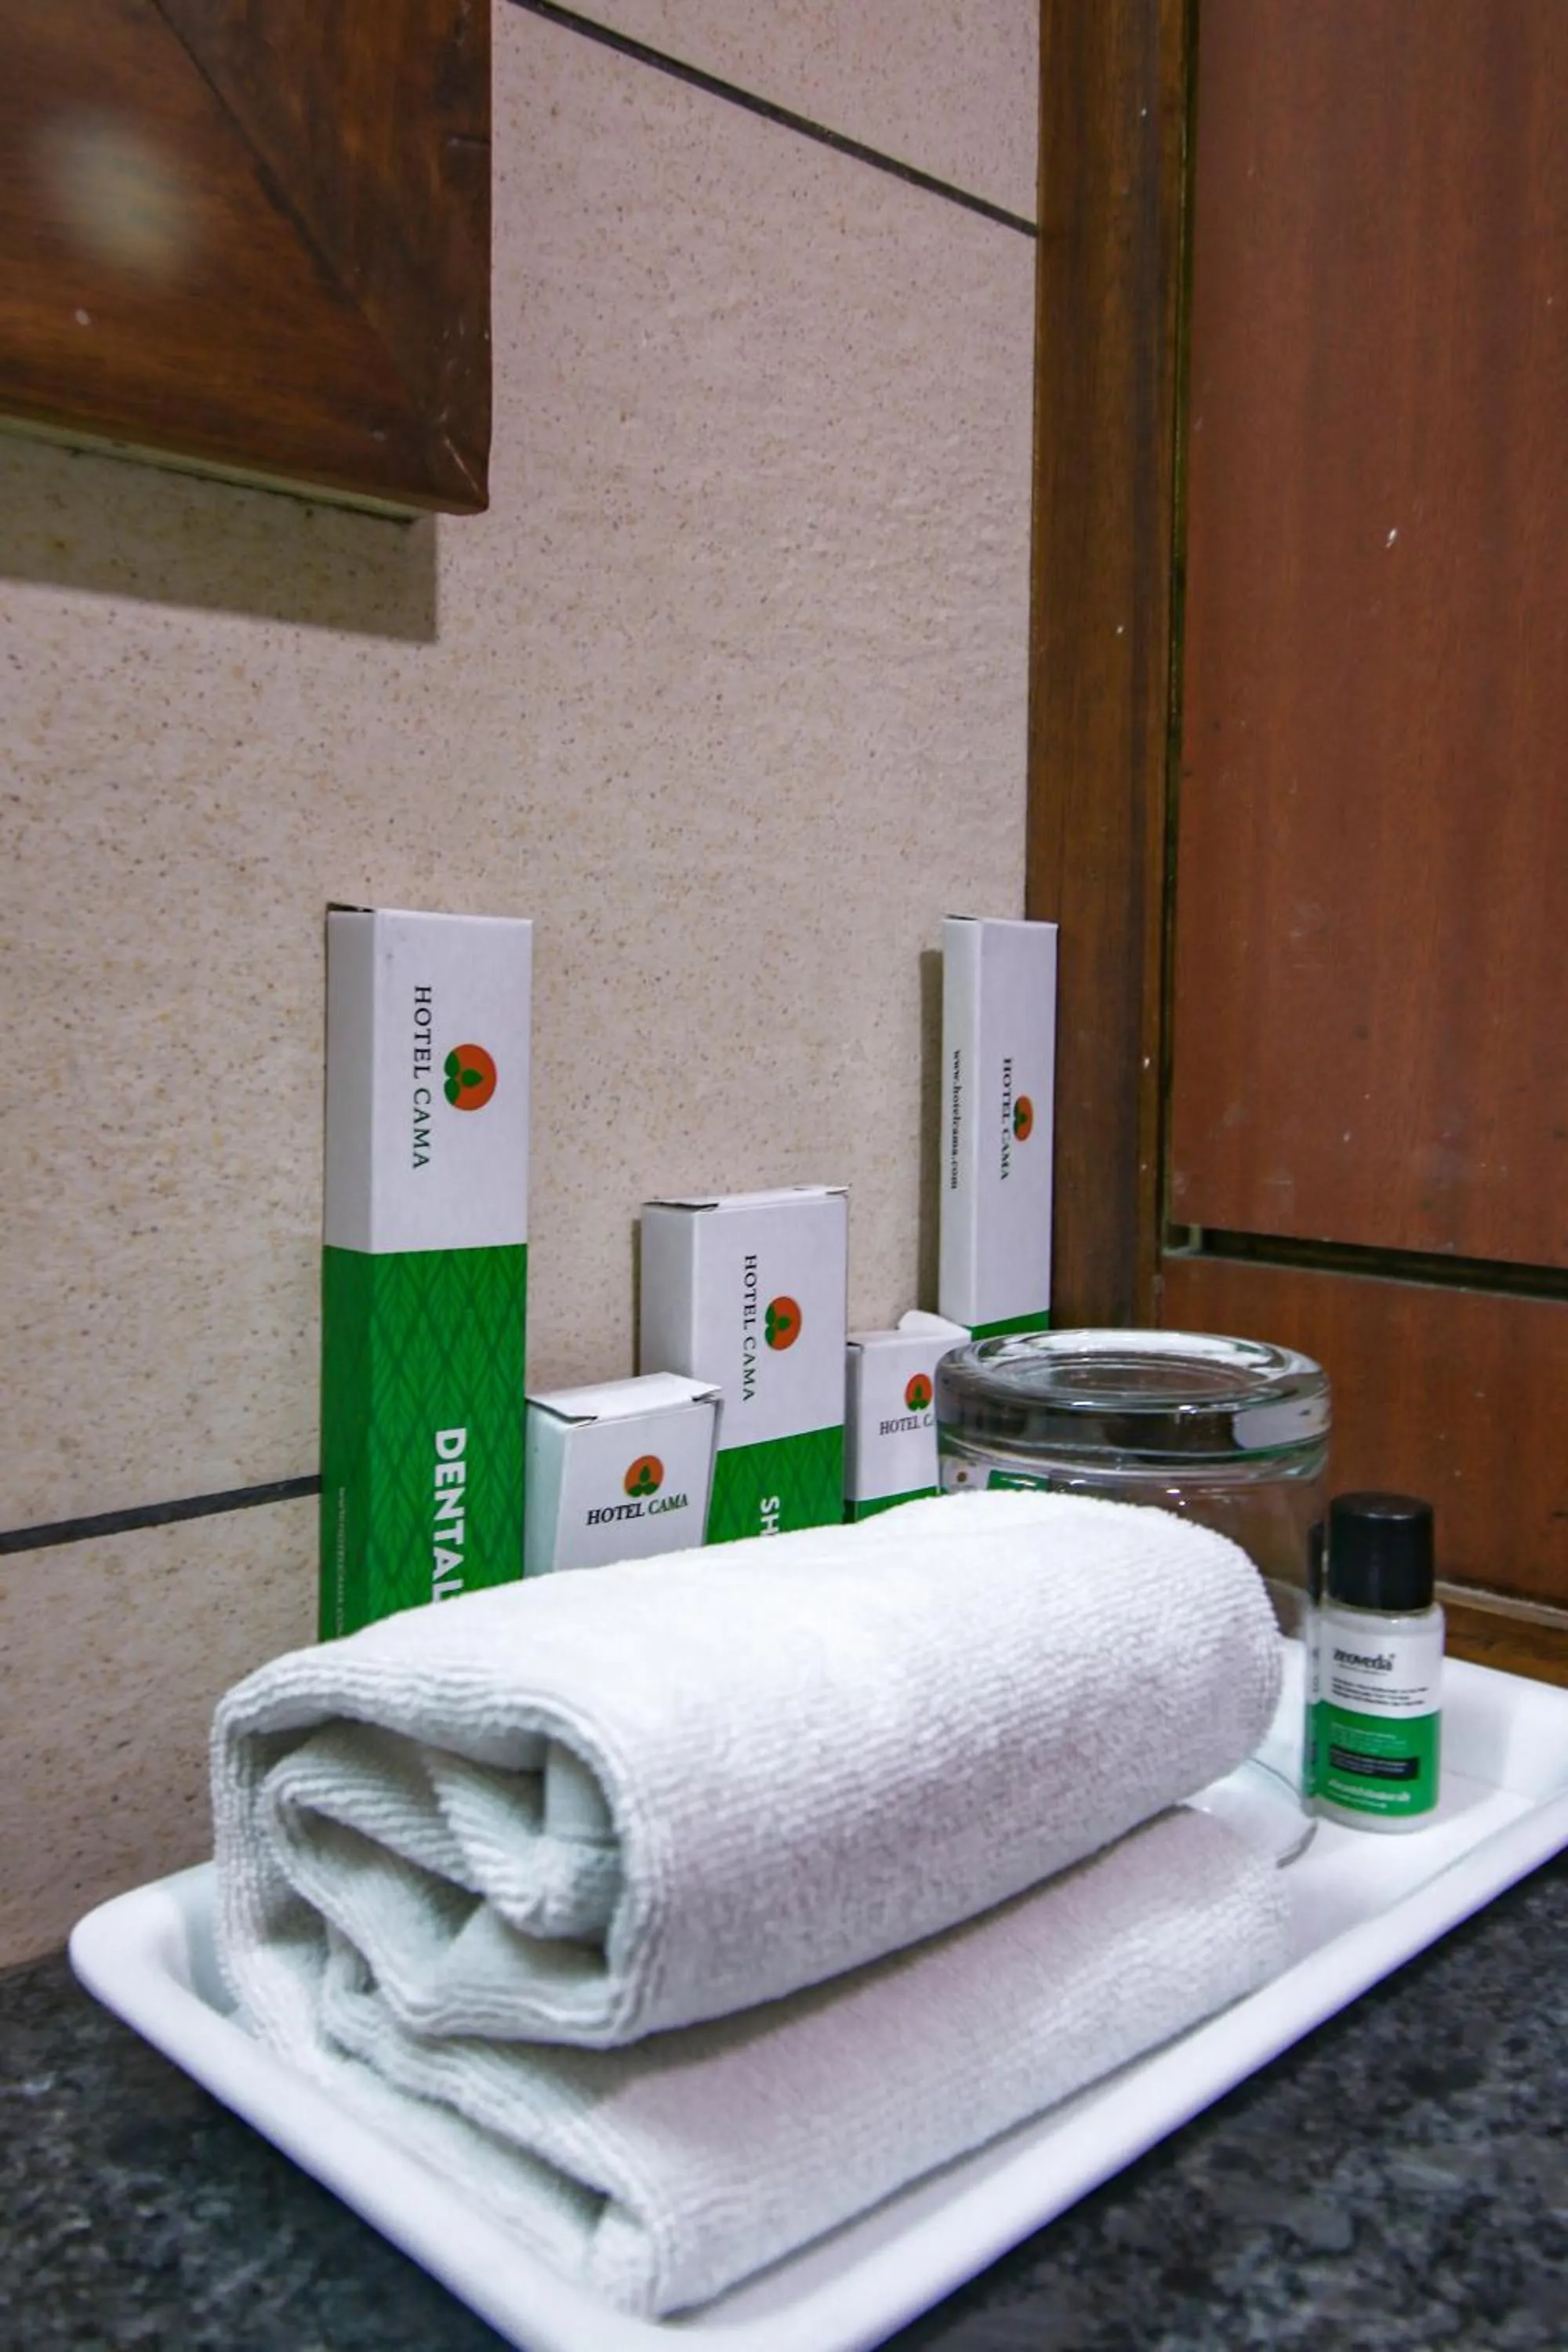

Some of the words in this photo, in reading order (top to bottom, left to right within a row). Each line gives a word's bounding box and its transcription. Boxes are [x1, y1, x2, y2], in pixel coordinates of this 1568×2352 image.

[412, 985, 432, 1080] HOTEL
[1002, 1058, 1013, 1124] HOTEL
[412, 1087, 430, 1170] CAMA
[1000, 1127, 1011, 1181] CAMA
[743, 1254, 758, 1330] HOTEL
[742, 1335, 757, 1402] CAMA
[880, 1415, 920, 1436] HOTEL
[432, 1428, 467, 1602] DENTAL
[586, 1501, 644, 1526] HOTEL
[647, 1494, 688, 1516] CAMA
